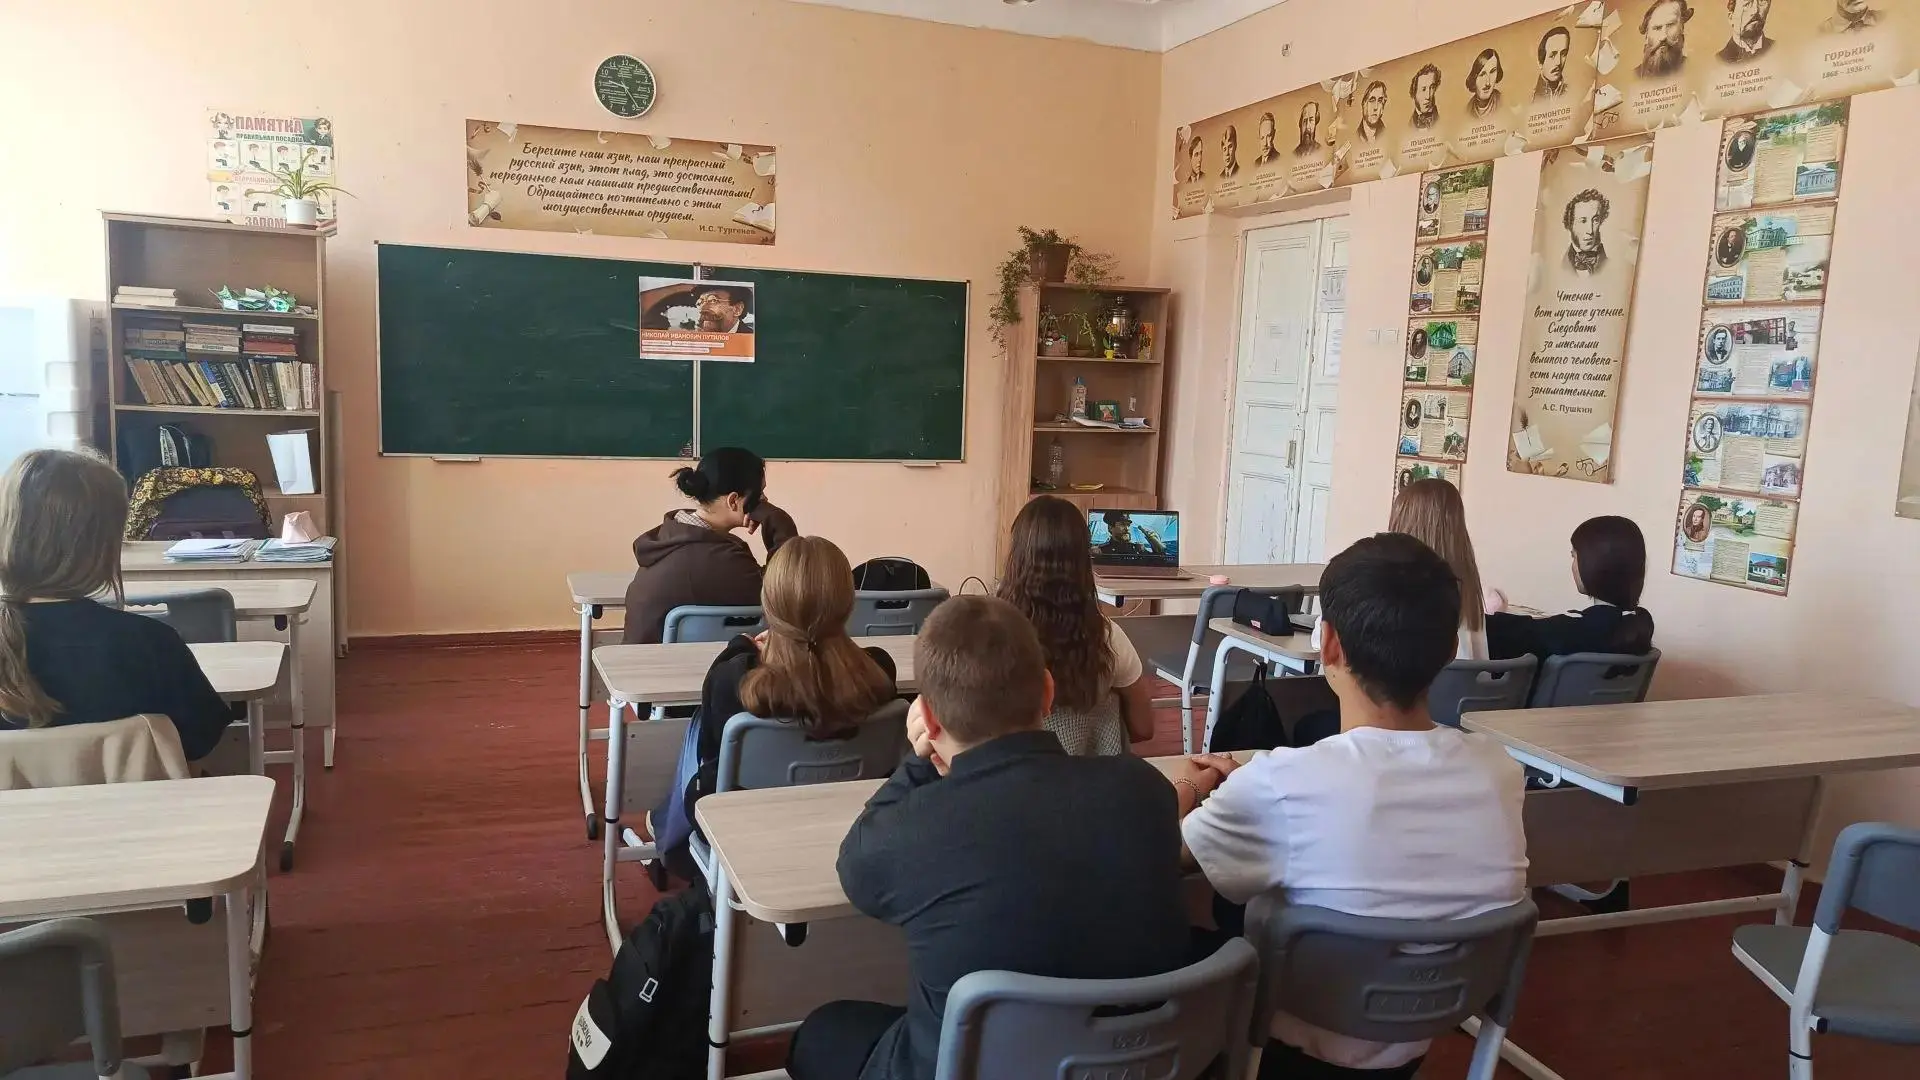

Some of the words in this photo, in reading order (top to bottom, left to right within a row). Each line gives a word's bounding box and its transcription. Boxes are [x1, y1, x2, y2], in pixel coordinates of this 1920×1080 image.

[1824, 42, 1875, 62] ГОРЬКИЙ
[1728, 68, 1760, 80] ЧЕХОВ
[1640, 84, 1678, 99] ТОЛСТОЙ
[1528, 107, 1571, 122] ЛЕРМОНТОВ
[235, 116, 304, 133] ПАМЯТКА
[1471, 123, 1495, 134] ГОГОЛЬ
[522, 142, 577, 158] Берегите
[579, 150, 604, 160] наш
[606, 152, 633, 165] язык,
[636, 155, 661, 164] наш
[662, 157, 726, 171] прекрасный
[508, 157, 556, 171] русский
[557, 161, 585, 175] язык,
[587, 164, 620, 175] этот
[622, 166, 650, 179] клад,
[652, 169, 674, 178] это
[675, 172, 736, 185] достояние,
[489, 170, 557, 185] переданное
[559, 177, 585, 186] нам
[586, 178, 634, 189] нашими
[636, 181, 756, 199] предшественниками!
[526, 184, 604, 201] Обращайтесь
[606, 193, 681, 207] почтительно
[683, 200, 689, 208] с
[691, 200, 722, 210] этим
[542, 202, 645, 217] могущественным
[646, 209, 695, 223] орудием.
[244, 215, 287, 229] ЗАПОМ
[1556, 289, 1594, 302] Чтение
[1534, 305, 1552, 318] вот
[1554, 309, 1588, 322] лучшее
[1588, 307, 1625, 322] учение.
[641, 331, 670, 339] НИКОЛАЙ
[1547, 320, 1597, 338] Следовать
[1541, 340, 1553, 353] за
[1555, 340, 1600, 349] мыслями
[1529, 351, 1568, 365] великого
[1571, 352, 1611, 366] человека
[1529, 370, 1550, 380] есть
[1551, 372, 1580, 385] наука
[1582, 373, 1613, 382] самая
[1528, 386, 1607, 399] занимательная.
[1559, 403, 1593, 414] Пушкин
